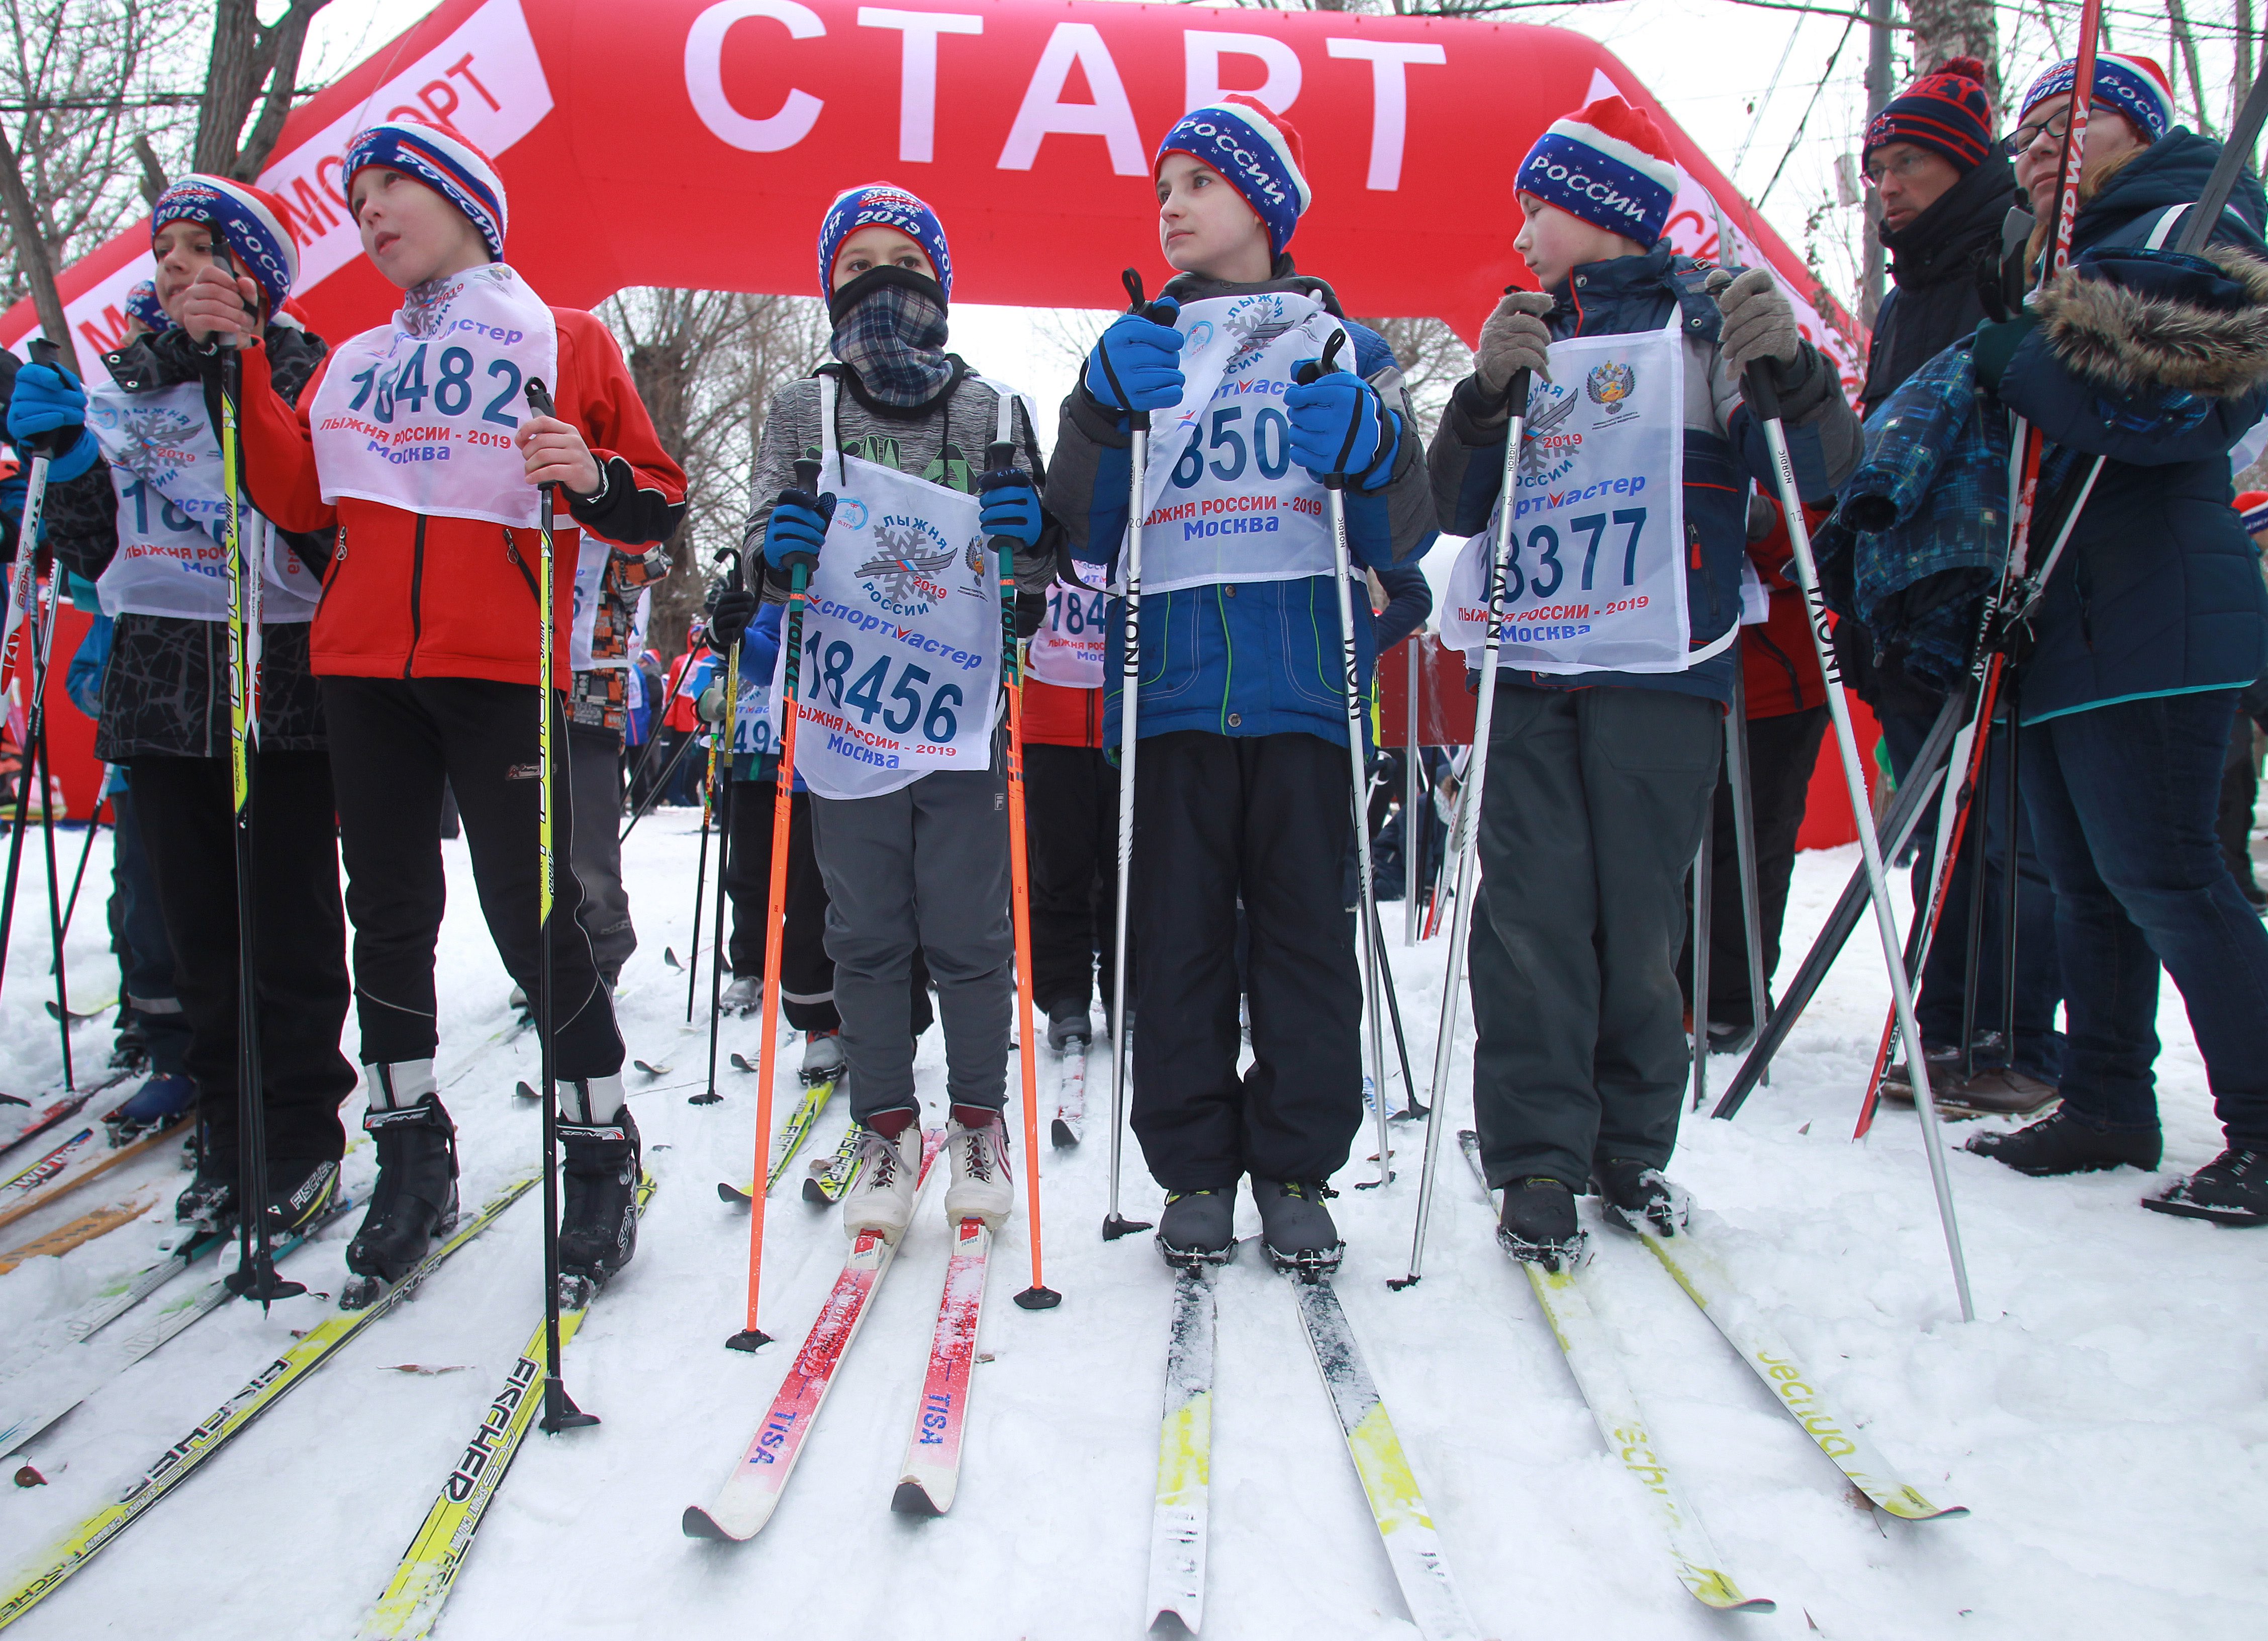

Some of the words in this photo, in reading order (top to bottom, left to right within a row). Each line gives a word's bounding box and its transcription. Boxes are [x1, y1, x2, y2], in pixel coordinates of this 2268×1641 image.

[684, 0, 1447, 191] СТАРТ
[1173, 120, 1286, 205] РОССИИ
[1529, 155, 1648, 222] РОССИИ
[2054, 96, 2089, 270] ORDWAY
[855, 210, 921, 235] 2019
[229, 219, 292, 303] РОСС
[1227, 294, 1283, 320] ЛЫЖНЯ
[348, 343, 522, 429] 18482
[320, 417, 390, 443] ЛЫЖНЯ
[467, 430, 512, 449] 2019
[1171, 406, 1292, 489] 850
[1542, 433, 1583, 449] 2019
[157, 448, 196, 463] 2019
[1507, 442, 1517, 472] NORDIC
[1778, 449, 1792, 484] NORDIC
[1143, 502, 1197, 527] ЫЖНЯ
[1201, 496, 1277, 516] РОССИИ
[1293, 496, 1322, 516] 2019
[883, 515, 947, 550] ЛЫЖНЯ
[1336, 517, 1346, 548] NORDIC
[124, 544, 193, 561] ЛЫЖНЯ
[862, 581, 929, 616] РОССИИ
[913, 576, 947, 599] 2019
[1048, 591, 1105, 634] 184
[1458, 607, 1515, 623] ЛЫЖЯ
[1517, 604, 1590, 623] РОССИИ
[1606, 596, 1649, 616] 2019
[1047, 638, 1085, 650] ЛЫЖНЯ
[1087, 643, 1105, 651] РОС
[805, 630, 964, 744] 18456
[798, 703, 843, 732] ЫЖНЯ
[915, 744, 957, 756] 2019
[374, 1112, 427, 1125] SPINE
[559, 1130, 611, 1139] SPINE
[290, 1159, 335, 1211] FISCHER
[855, 1250, 873, 1260] JUNIOR
[961, 1237, 978, 1247] JUNIOR
[391, 1253, 442, 1306] FISCHER
[441, 1354, 542, 1504] FISCHER
[919, 1392, 952, 1445] TISA
[749, 1410, 797, 1467] TISA
[0, 1548, 83, 1622] FISCHE
